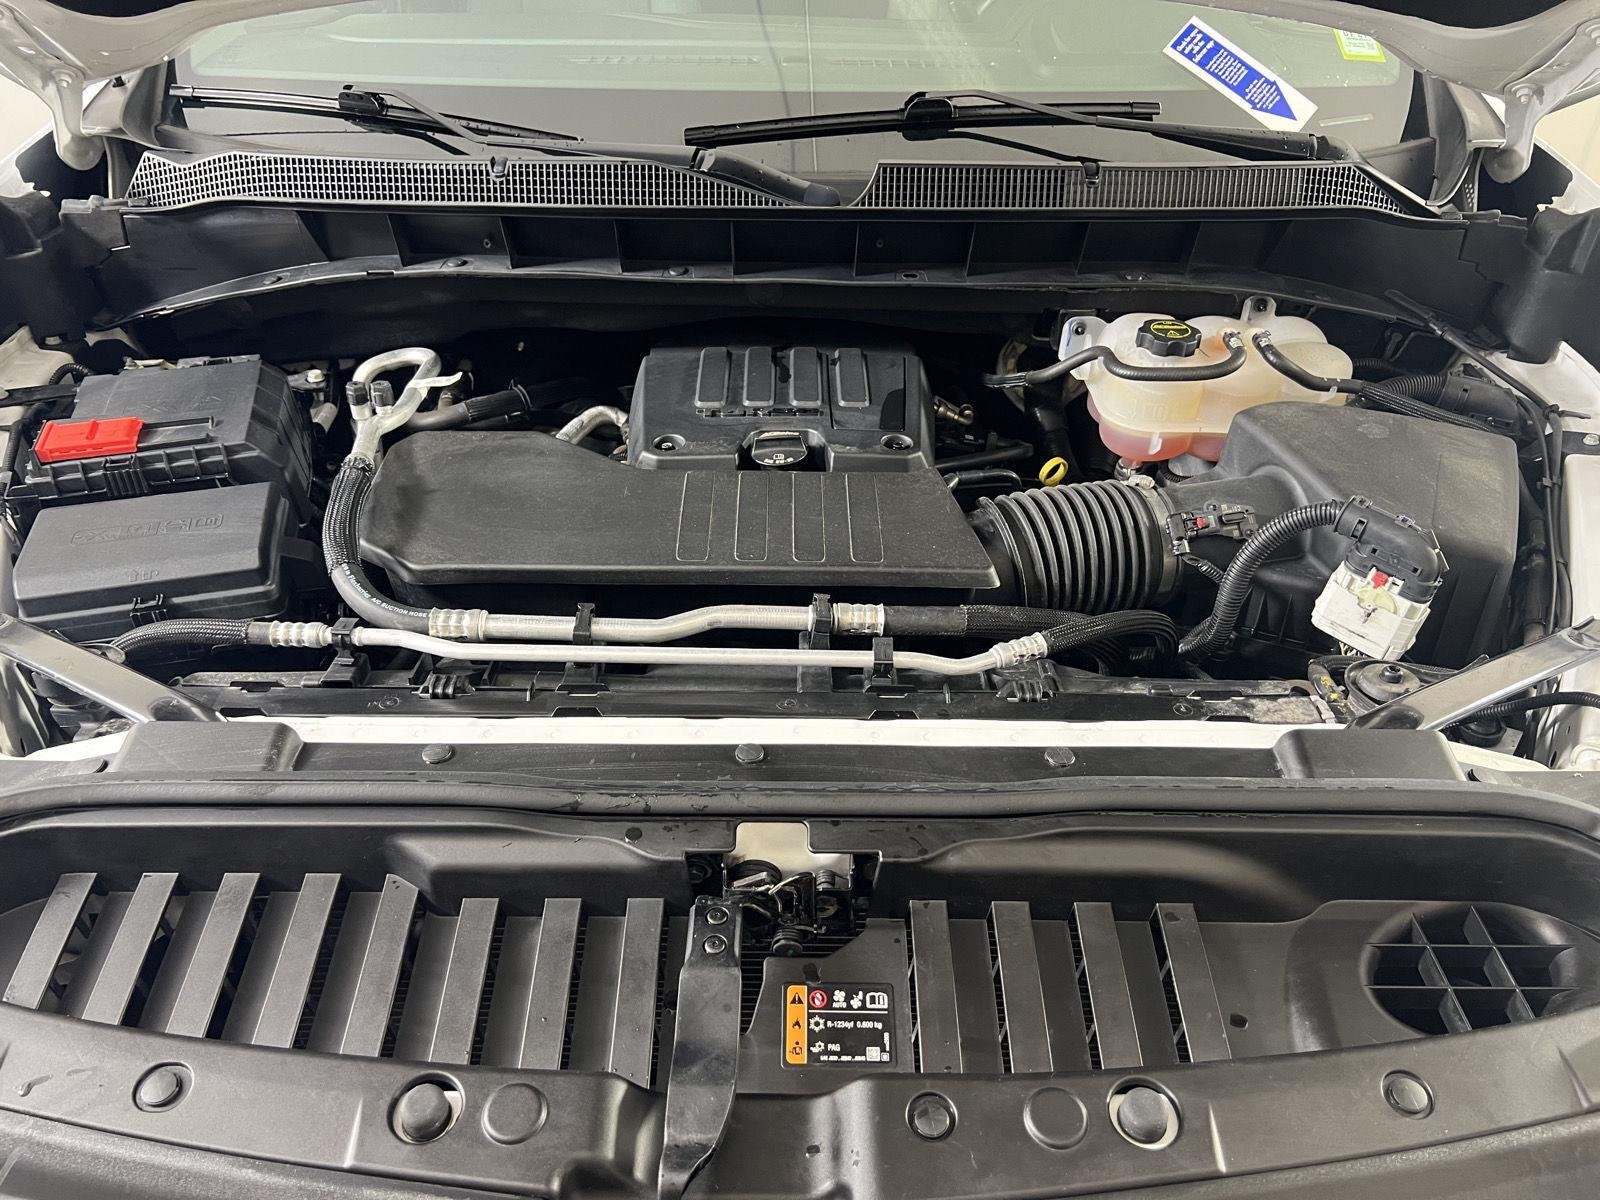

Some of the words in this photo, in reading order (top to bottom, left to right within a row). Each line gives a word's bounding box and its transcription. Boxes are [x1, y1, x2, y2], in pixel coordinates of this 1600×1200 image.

[380, 602, 409, 615] SUCTION
[874, 1020, 883, 1030] kg
[827, 1043, 841, 1051] PAG
